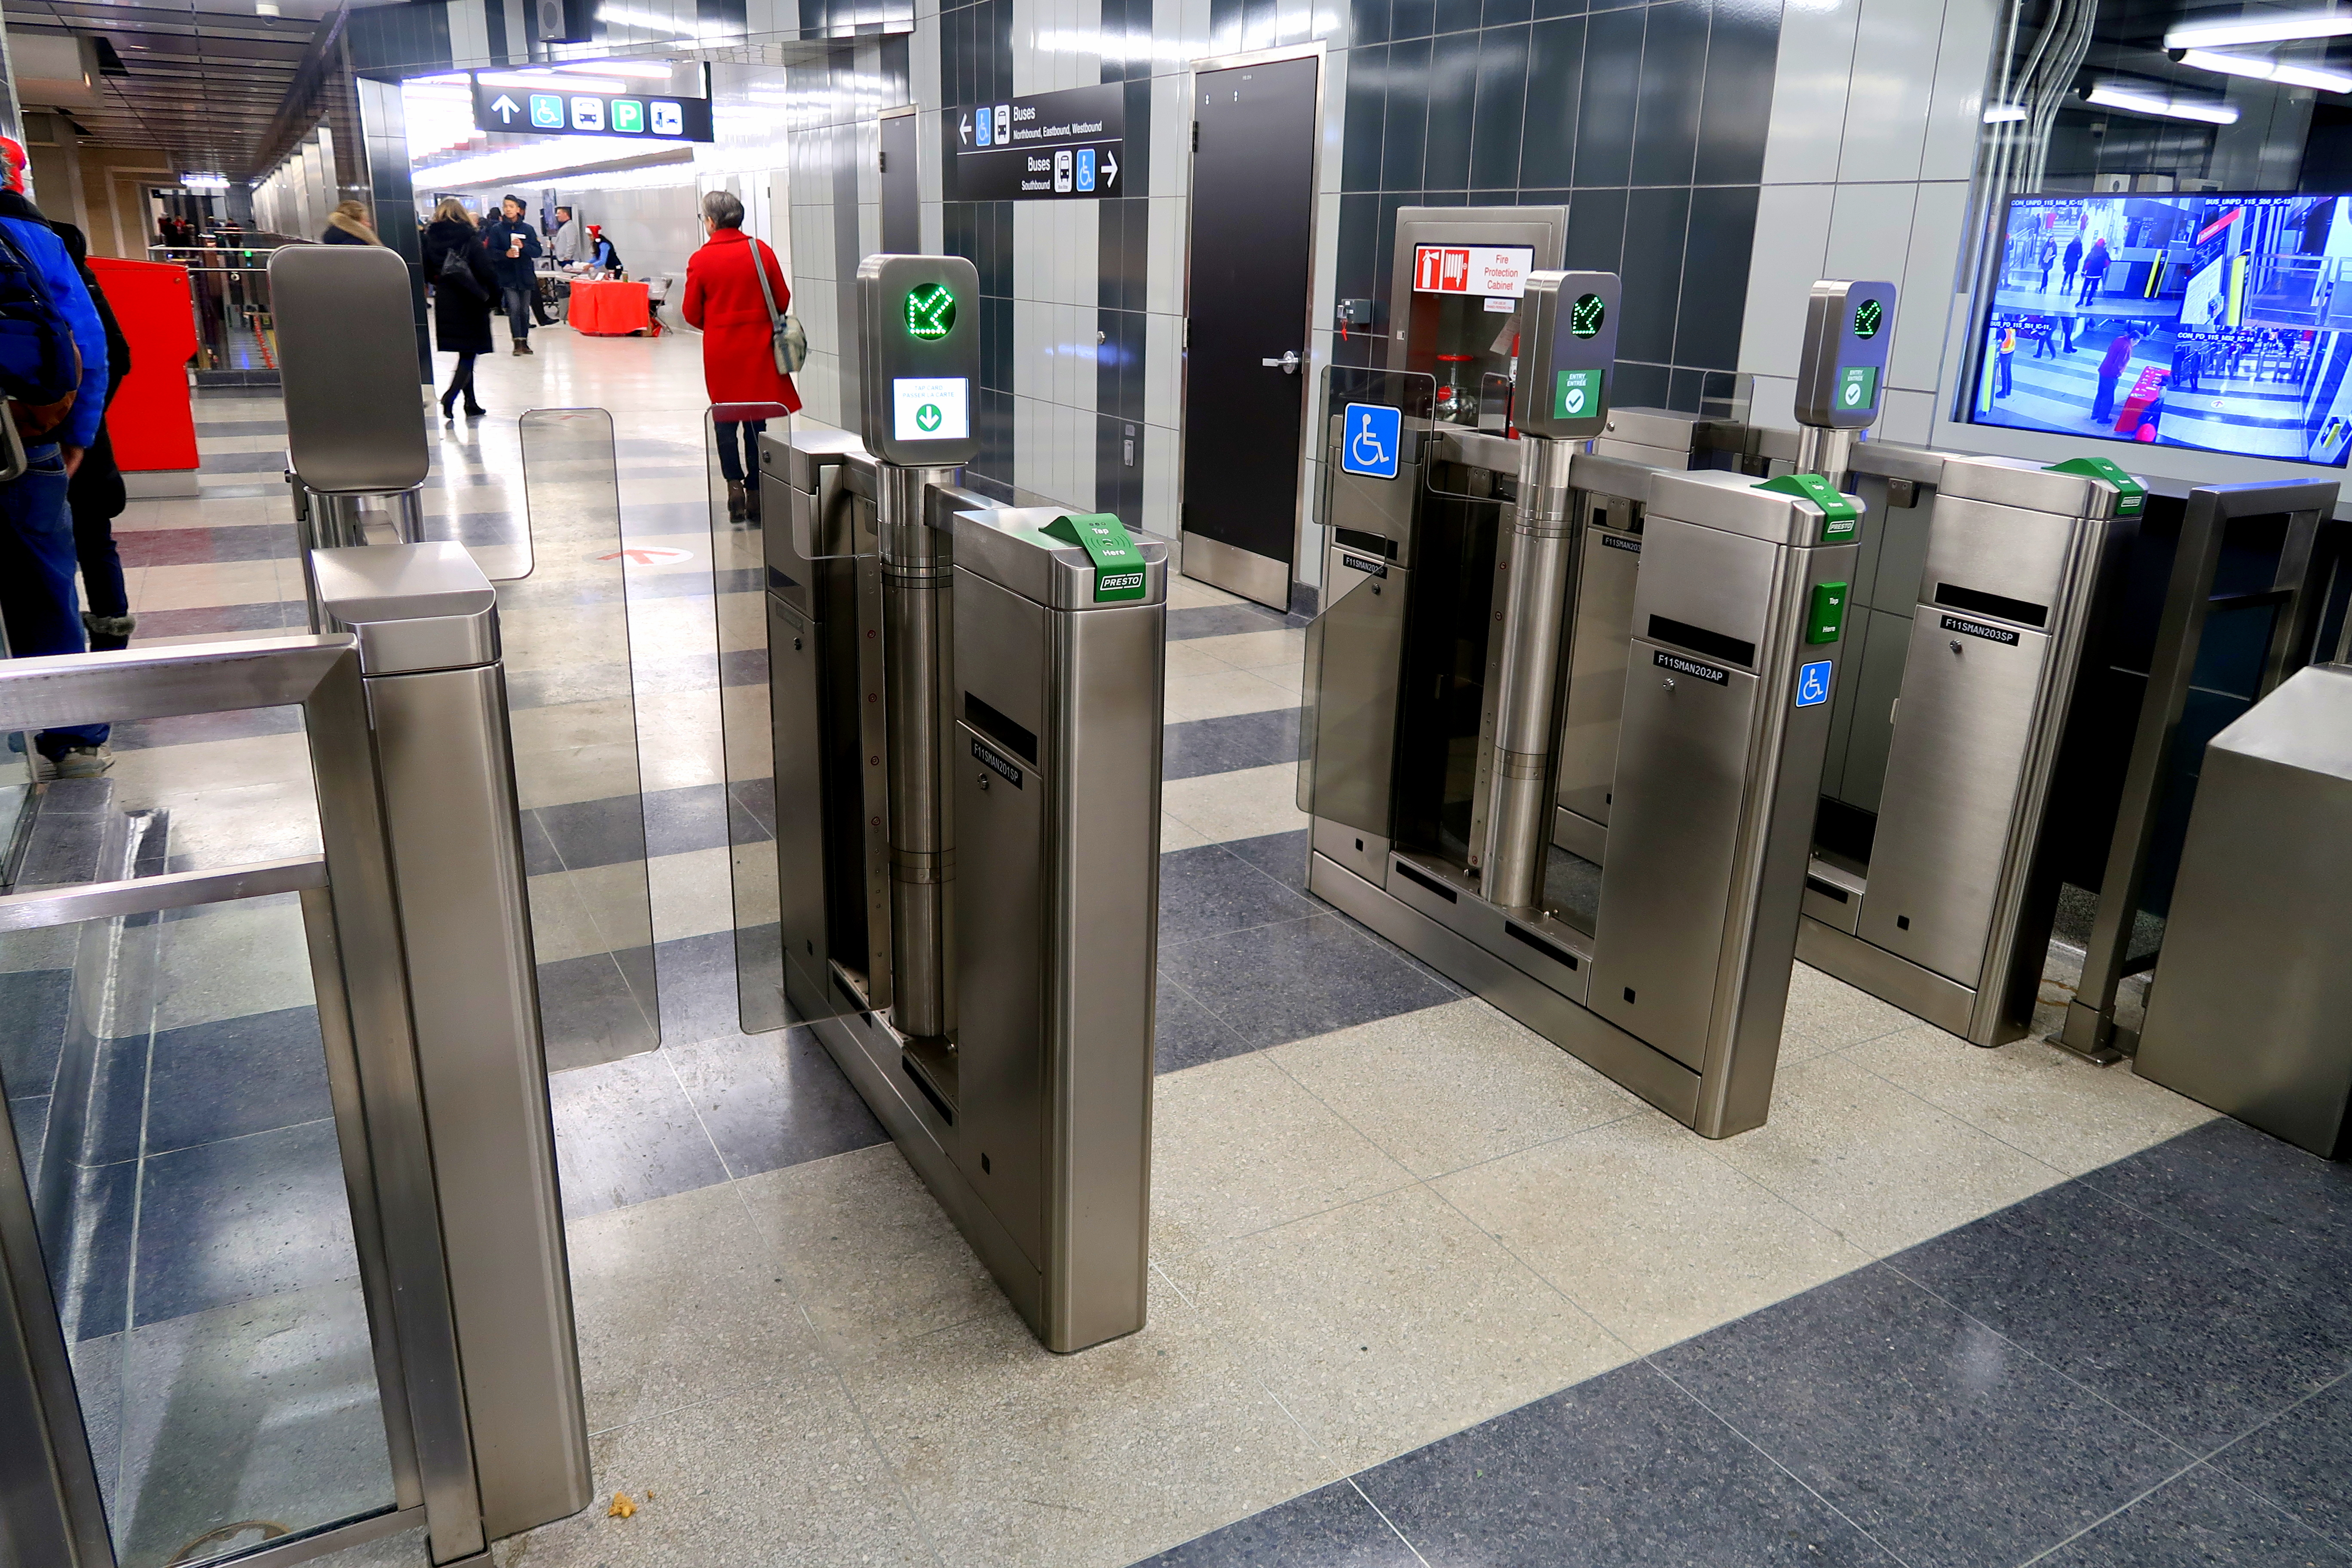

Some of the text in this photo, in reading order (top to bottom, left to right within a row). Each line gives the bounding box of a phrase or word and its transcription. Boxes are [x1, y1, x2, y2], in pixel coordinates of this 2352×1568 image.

[1013, 106, 1036, 122] Buses
[1013, 120, 1102, 140] Northbound, Eastbound, Westbound
[1028, 156, 1050, 172] Buses
[1021, 179, 1050, 191] Southbound
[1495, 254, 1509, 264] Fire
[1484, 266, 1519, 277] Protection
[1487, 279, 1514, 291] Cabinet
[1103, 576, 1139, 587] PRESTO
[1829, 597, 1839, 605] Tap
[1946, 619, 2013, 642] F11SMAN203SP
[1658, 654, 1723, 681] F11SMAN202AP
[974, 743, 1019, 782] F11SMAN201SP
